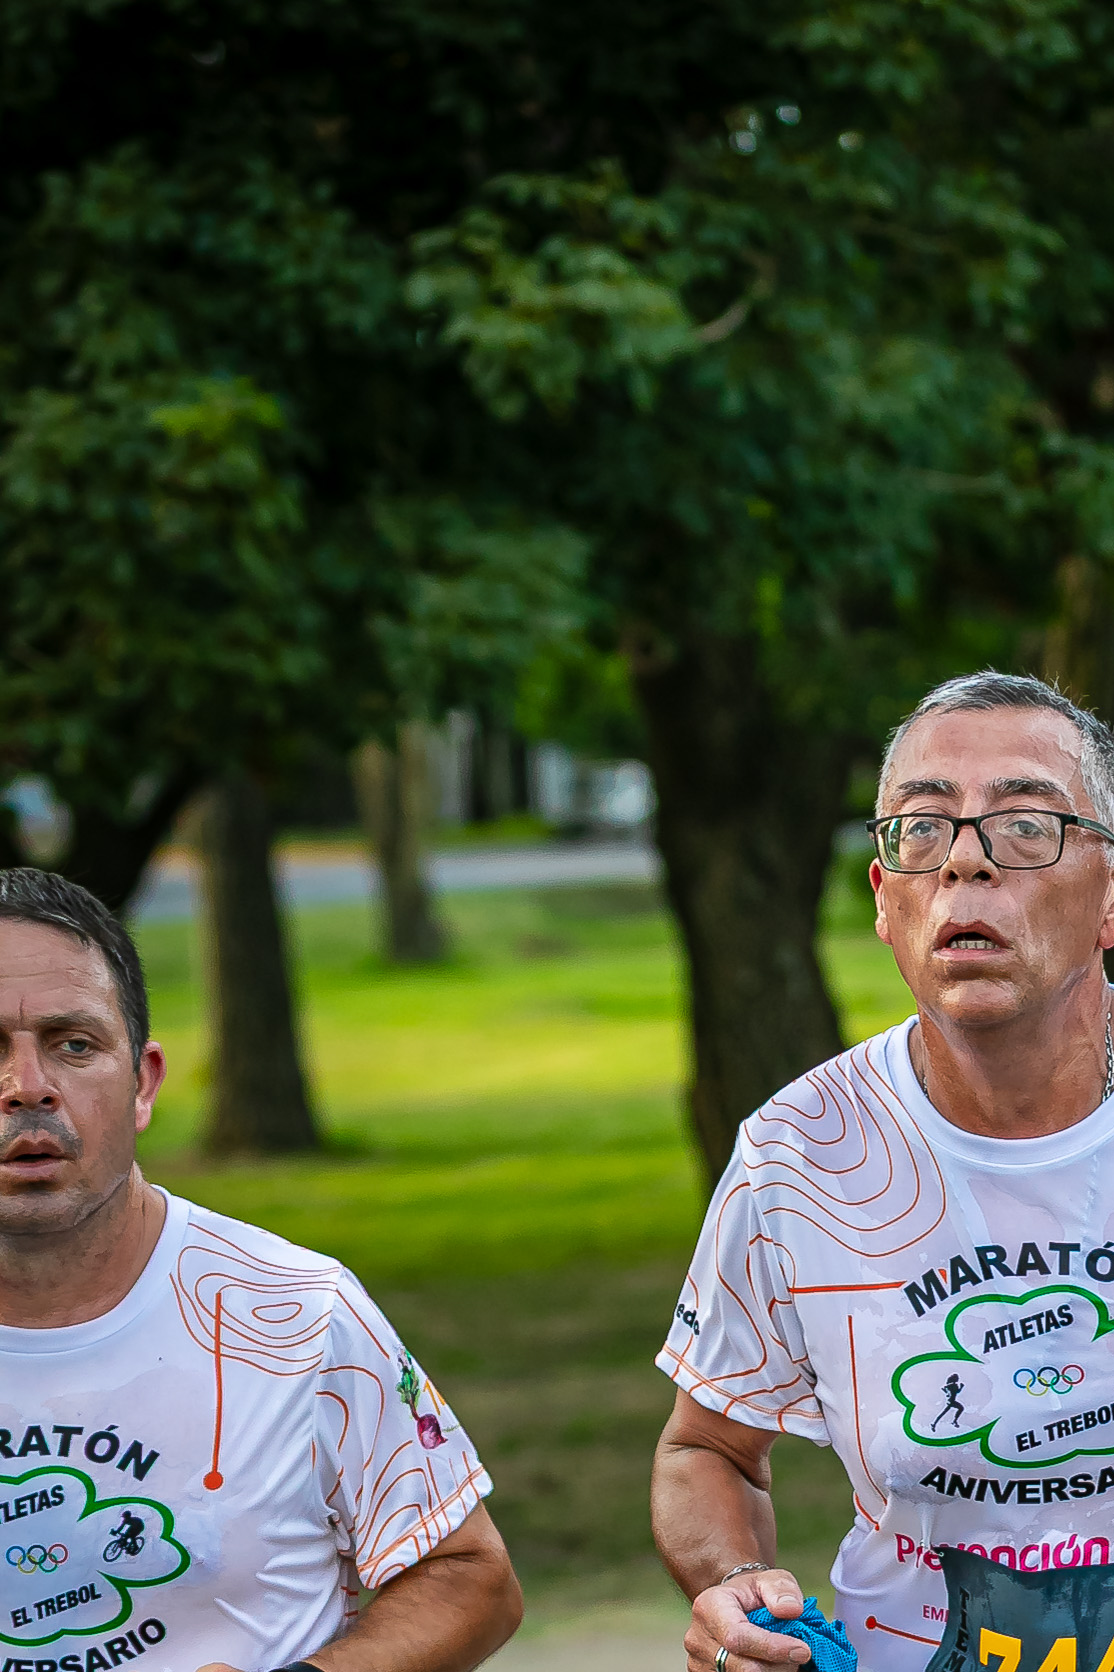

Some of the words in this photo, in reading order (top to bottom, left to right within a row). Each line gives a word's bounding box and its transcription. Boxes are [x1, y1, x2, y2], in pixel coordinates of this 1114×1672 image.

[982, 1303, 1075, 1354] ATLETAS
[1015, 1429, 1042, 1453] EL
[10, 1606, 32, 1629] EL
[33, 1582, 102, 1620] TREBOL
